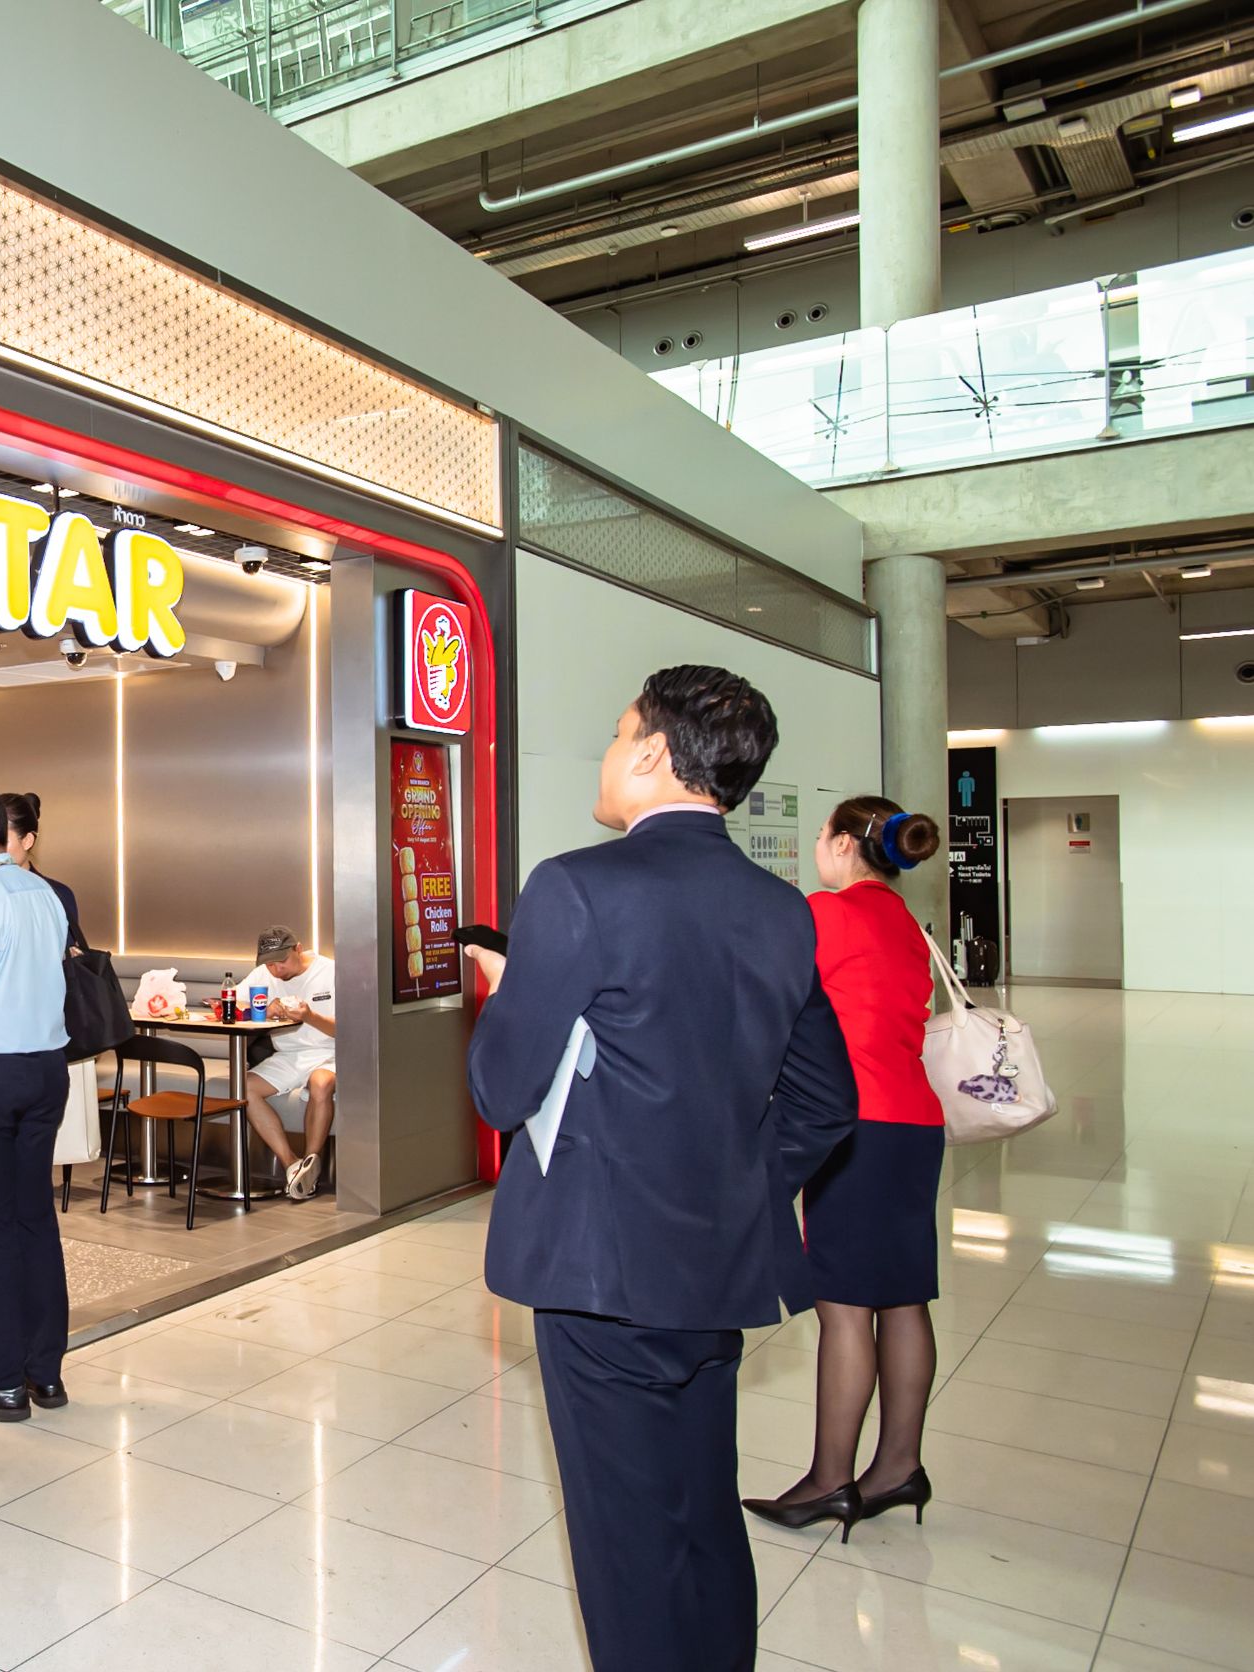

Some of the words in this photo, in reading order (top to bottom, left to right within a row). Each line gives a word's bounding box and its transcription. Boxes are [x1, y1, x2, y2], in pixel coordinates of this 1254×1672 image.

[113, 505, 146, 528] ห้าดาว
[404, 789, 436, 803] GRAND
[401, 803, 441, 819] OPENING
[422, 876, 452, 897] FREE
[424, 906, 453, 920] Chicken
[430, 921, 448, 933] Rolls
